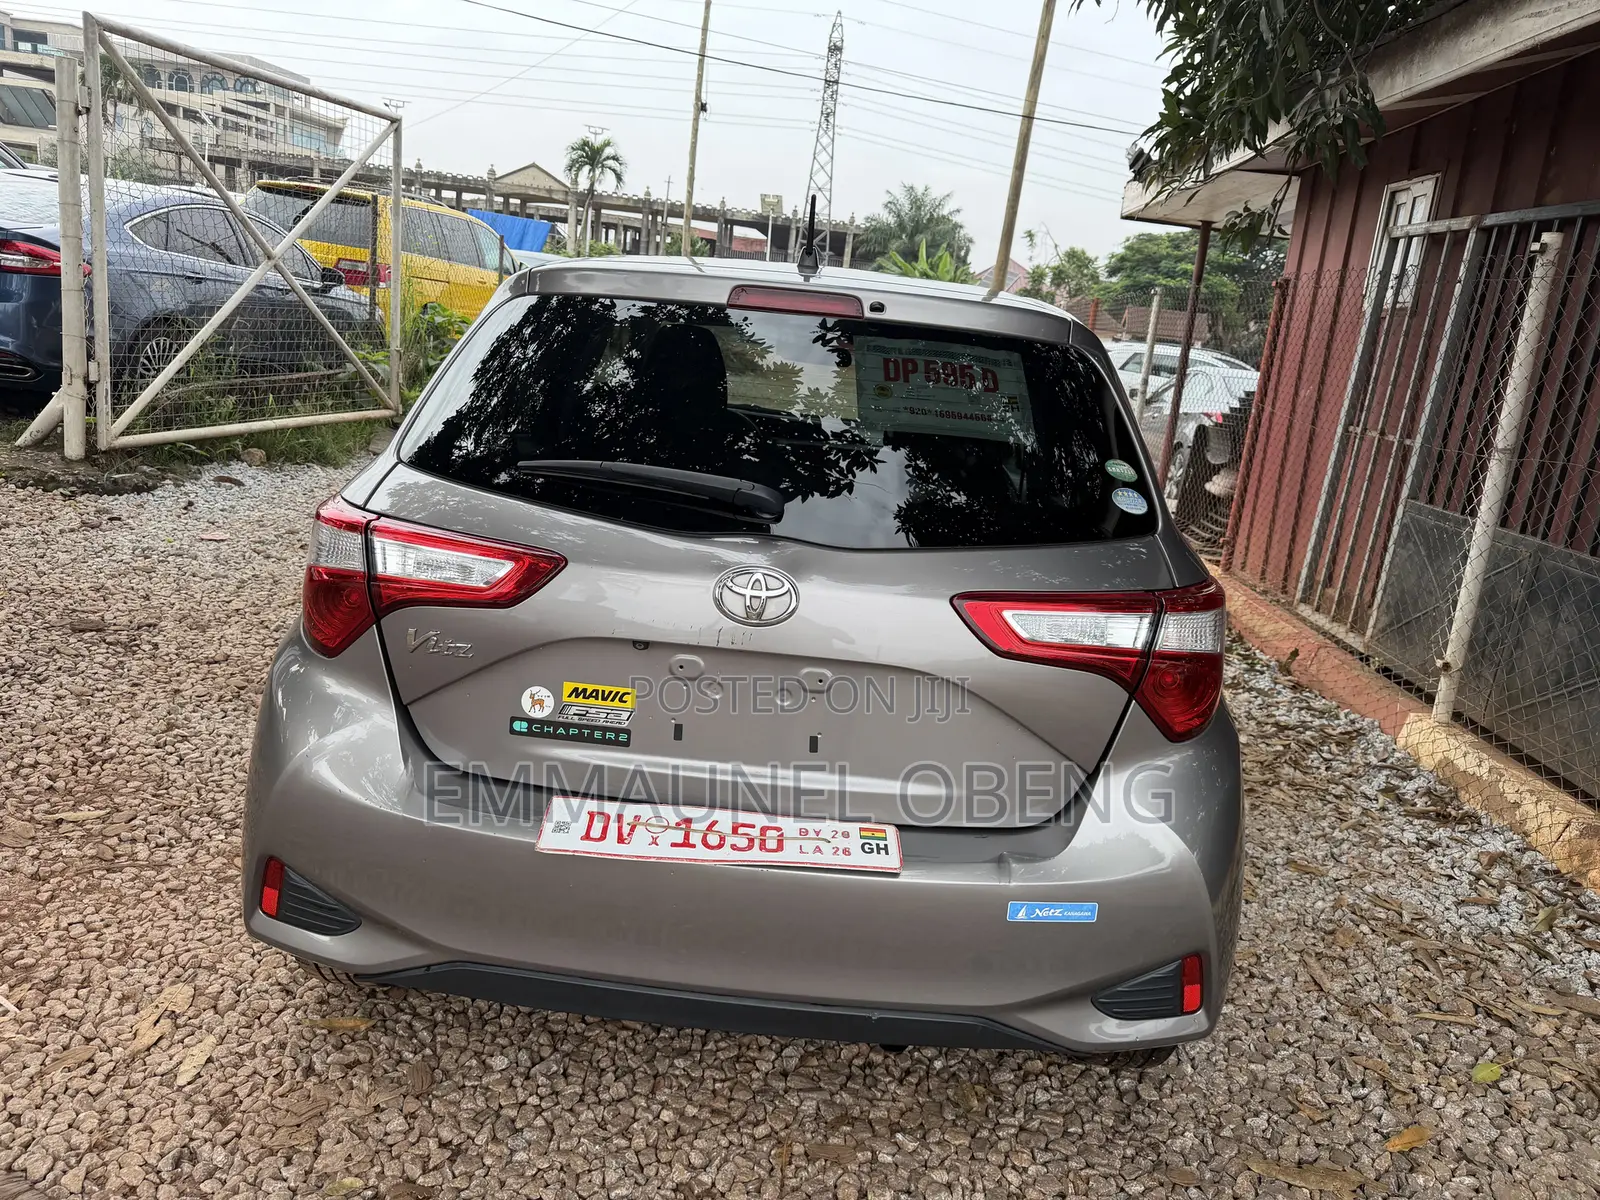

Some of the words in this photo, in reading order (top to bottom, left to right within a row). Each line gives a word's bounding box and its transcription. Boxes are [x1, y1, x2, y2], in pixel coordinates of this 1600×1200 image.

[883, 357, 918, 383] DP
[981, 366, 999, 393] D
[406, 628, 475, 658] Vitz
[567, 686, 632, 704] MAVIC
[580, 810, 642, 845] DV
[670, 817, 785, 853] 1650
[799, 844, 824, 855] LA
[860, 842, 889, 856] GH
[1030, 907, 1064, 918] Netz
